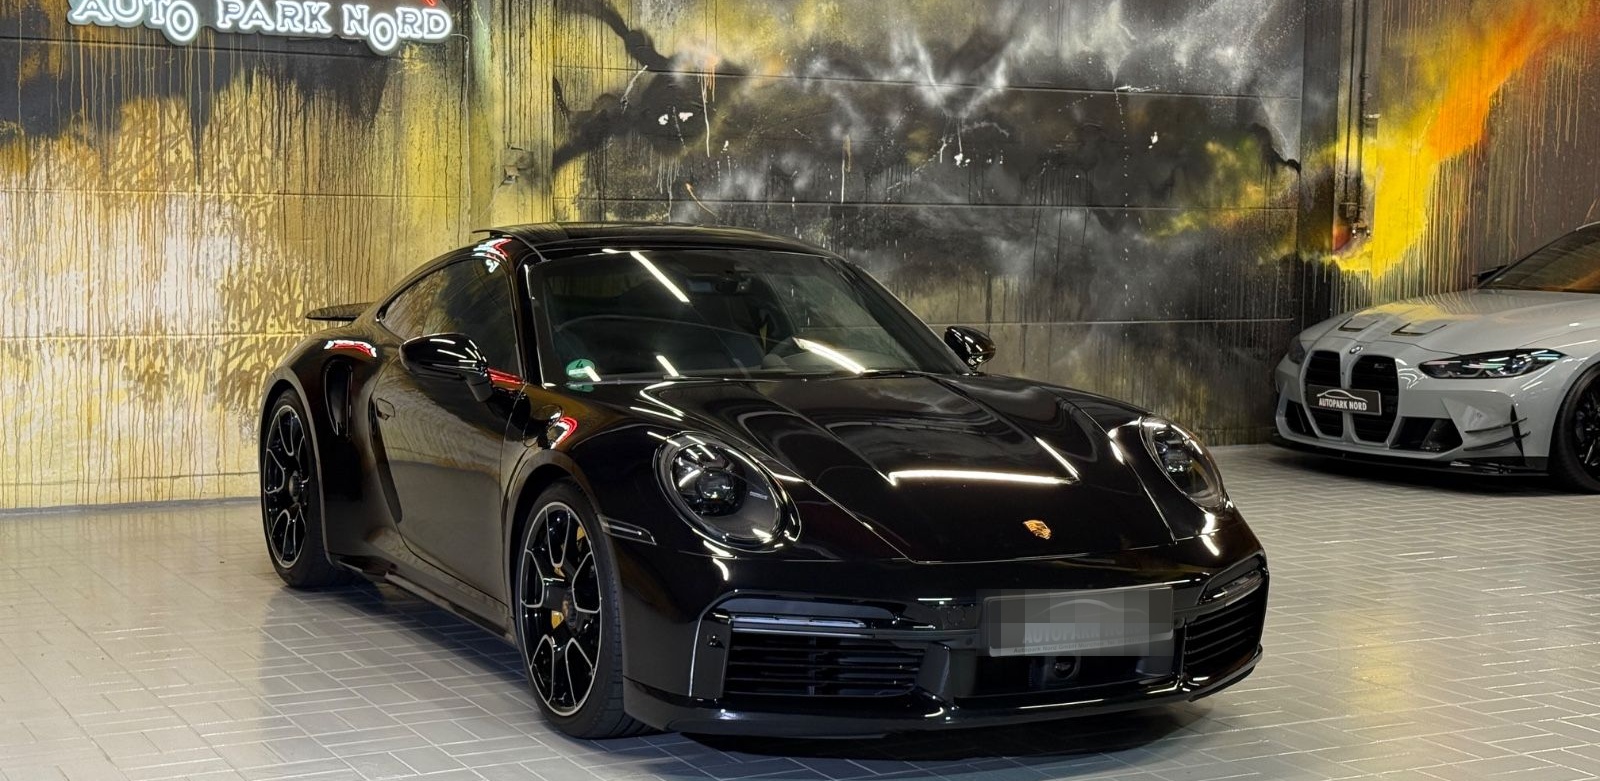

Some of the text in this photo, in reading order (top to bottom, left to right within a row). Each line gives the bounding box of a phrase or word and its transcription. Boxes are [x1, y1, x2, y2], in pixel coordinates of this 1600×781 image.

[72, 0, 451, 51] AUTO PARK NORD
[575, 360, 584, 368] 4
[1319, 398, 1367, 411] AUTOPARK NORD
